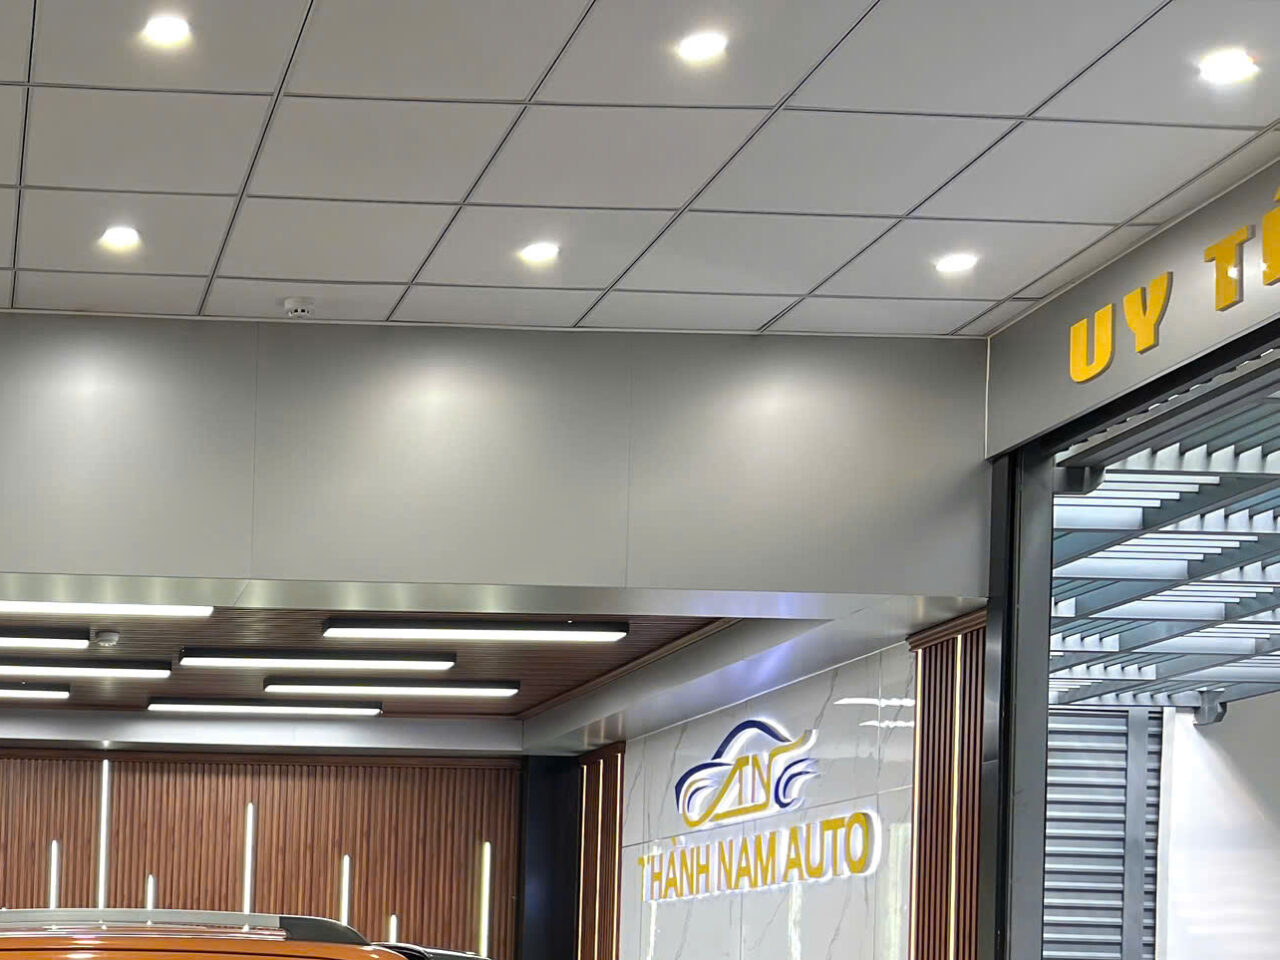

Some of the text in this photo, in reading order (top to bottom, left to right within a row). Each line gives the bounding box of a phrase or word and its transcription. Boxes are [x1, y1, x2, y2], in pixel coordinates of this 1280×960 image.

[1069, 271, 1173, 383] UY
[717, 830, 778, 891] NAM
[782, 811, 870, 882] AUTO
